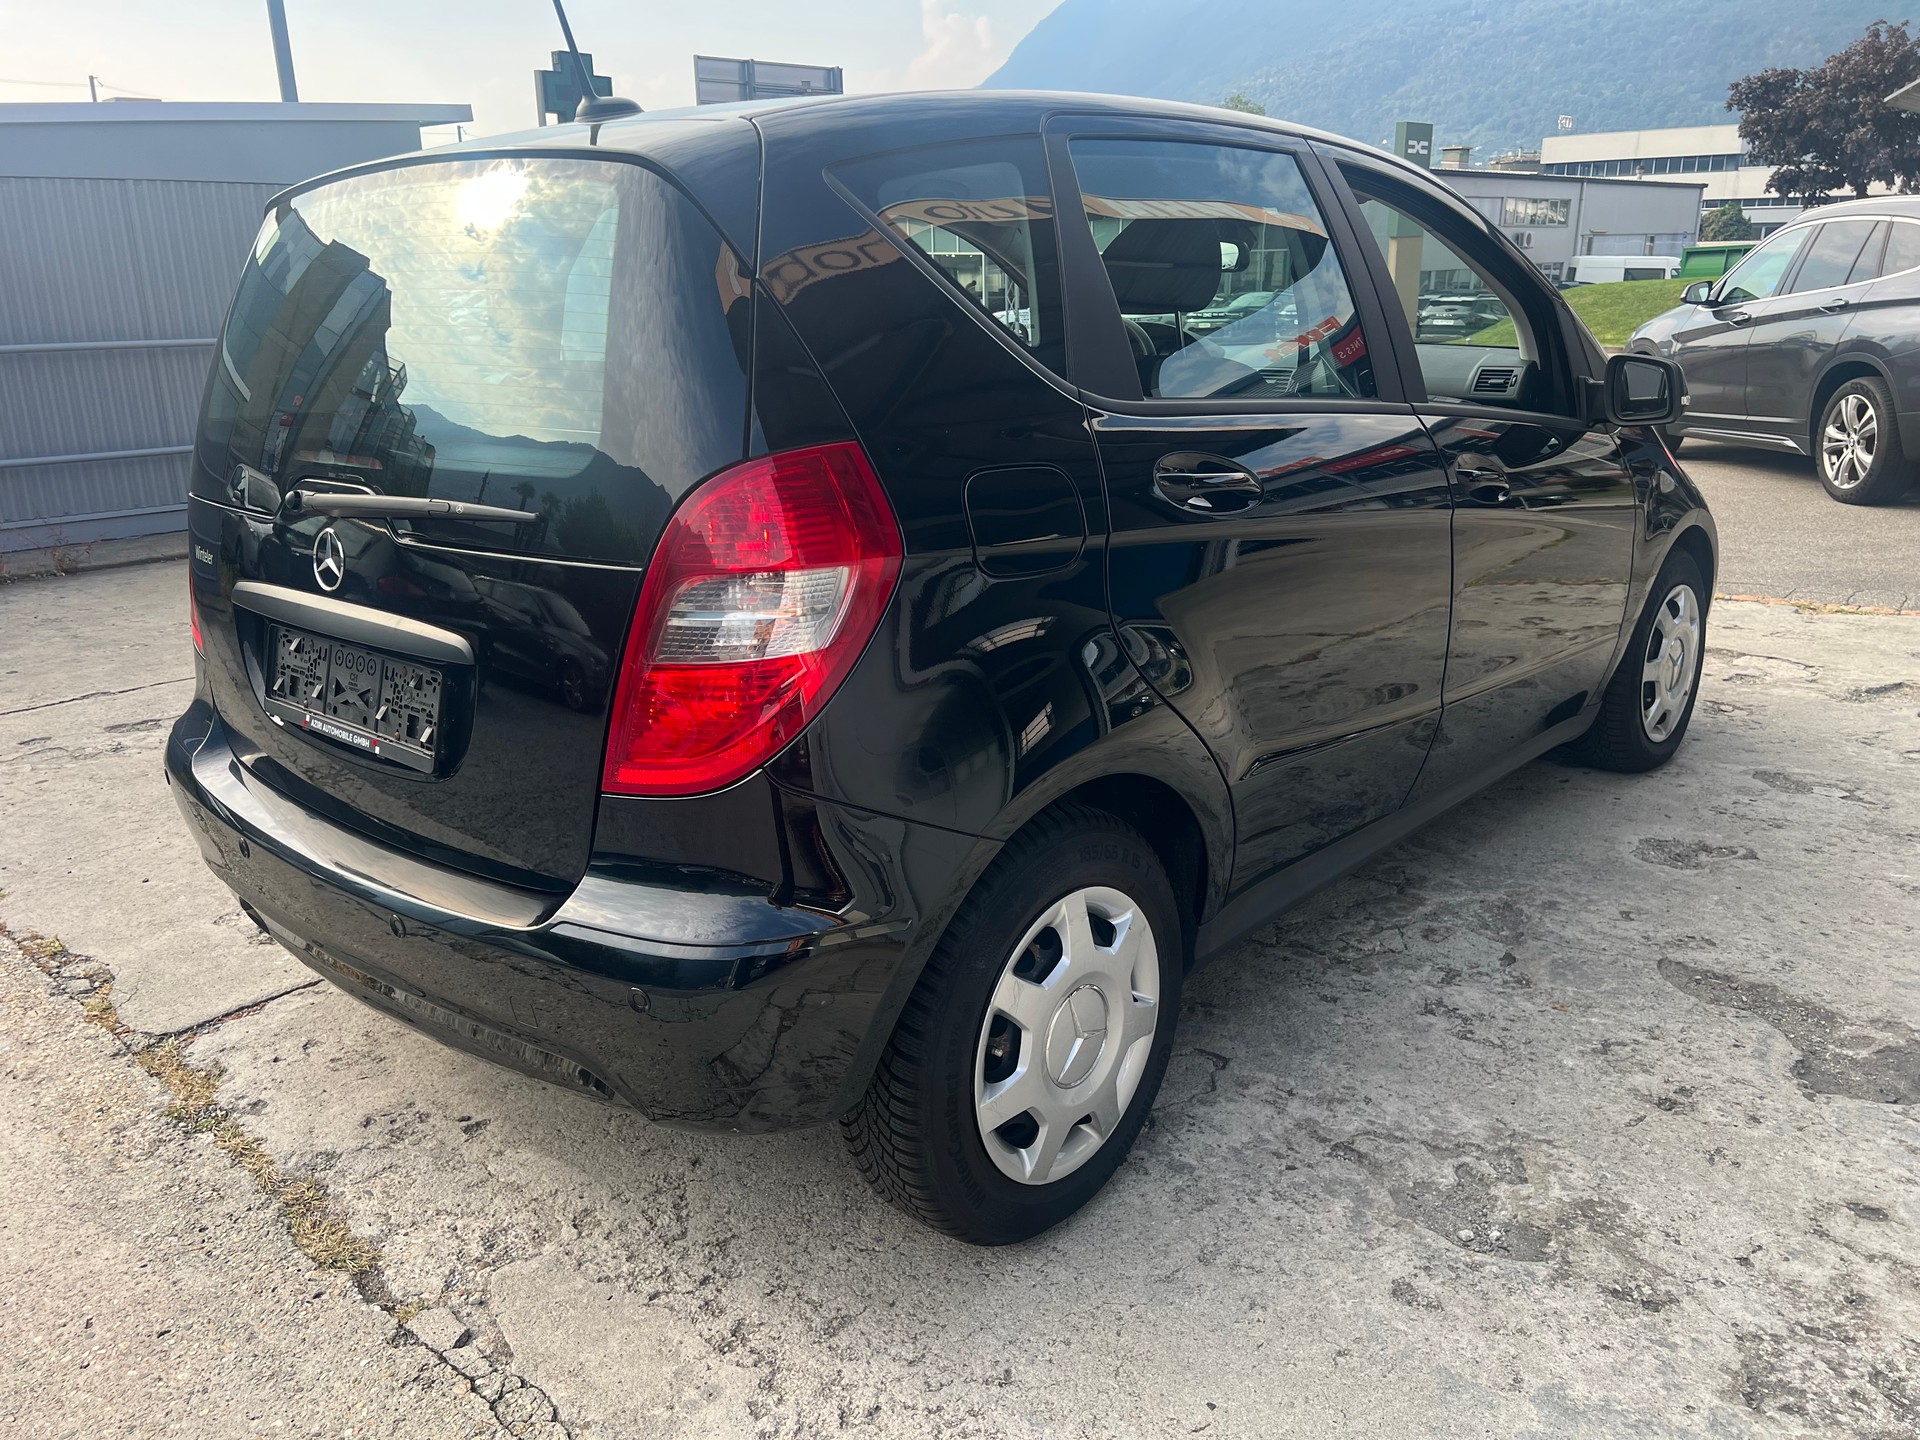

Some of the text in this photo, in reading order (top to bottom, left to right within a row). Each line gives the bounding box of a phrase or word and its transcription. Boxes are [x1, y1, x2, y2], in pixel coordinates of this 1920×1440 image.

[195, 544, 213, 565] Winteler
[310, 718, 370, 747] AZIRI AUTOMOBILE GMBH
[1078, 843, 1118, 864] 185/65
[944, 1072, 986, 1211] WinterContact
